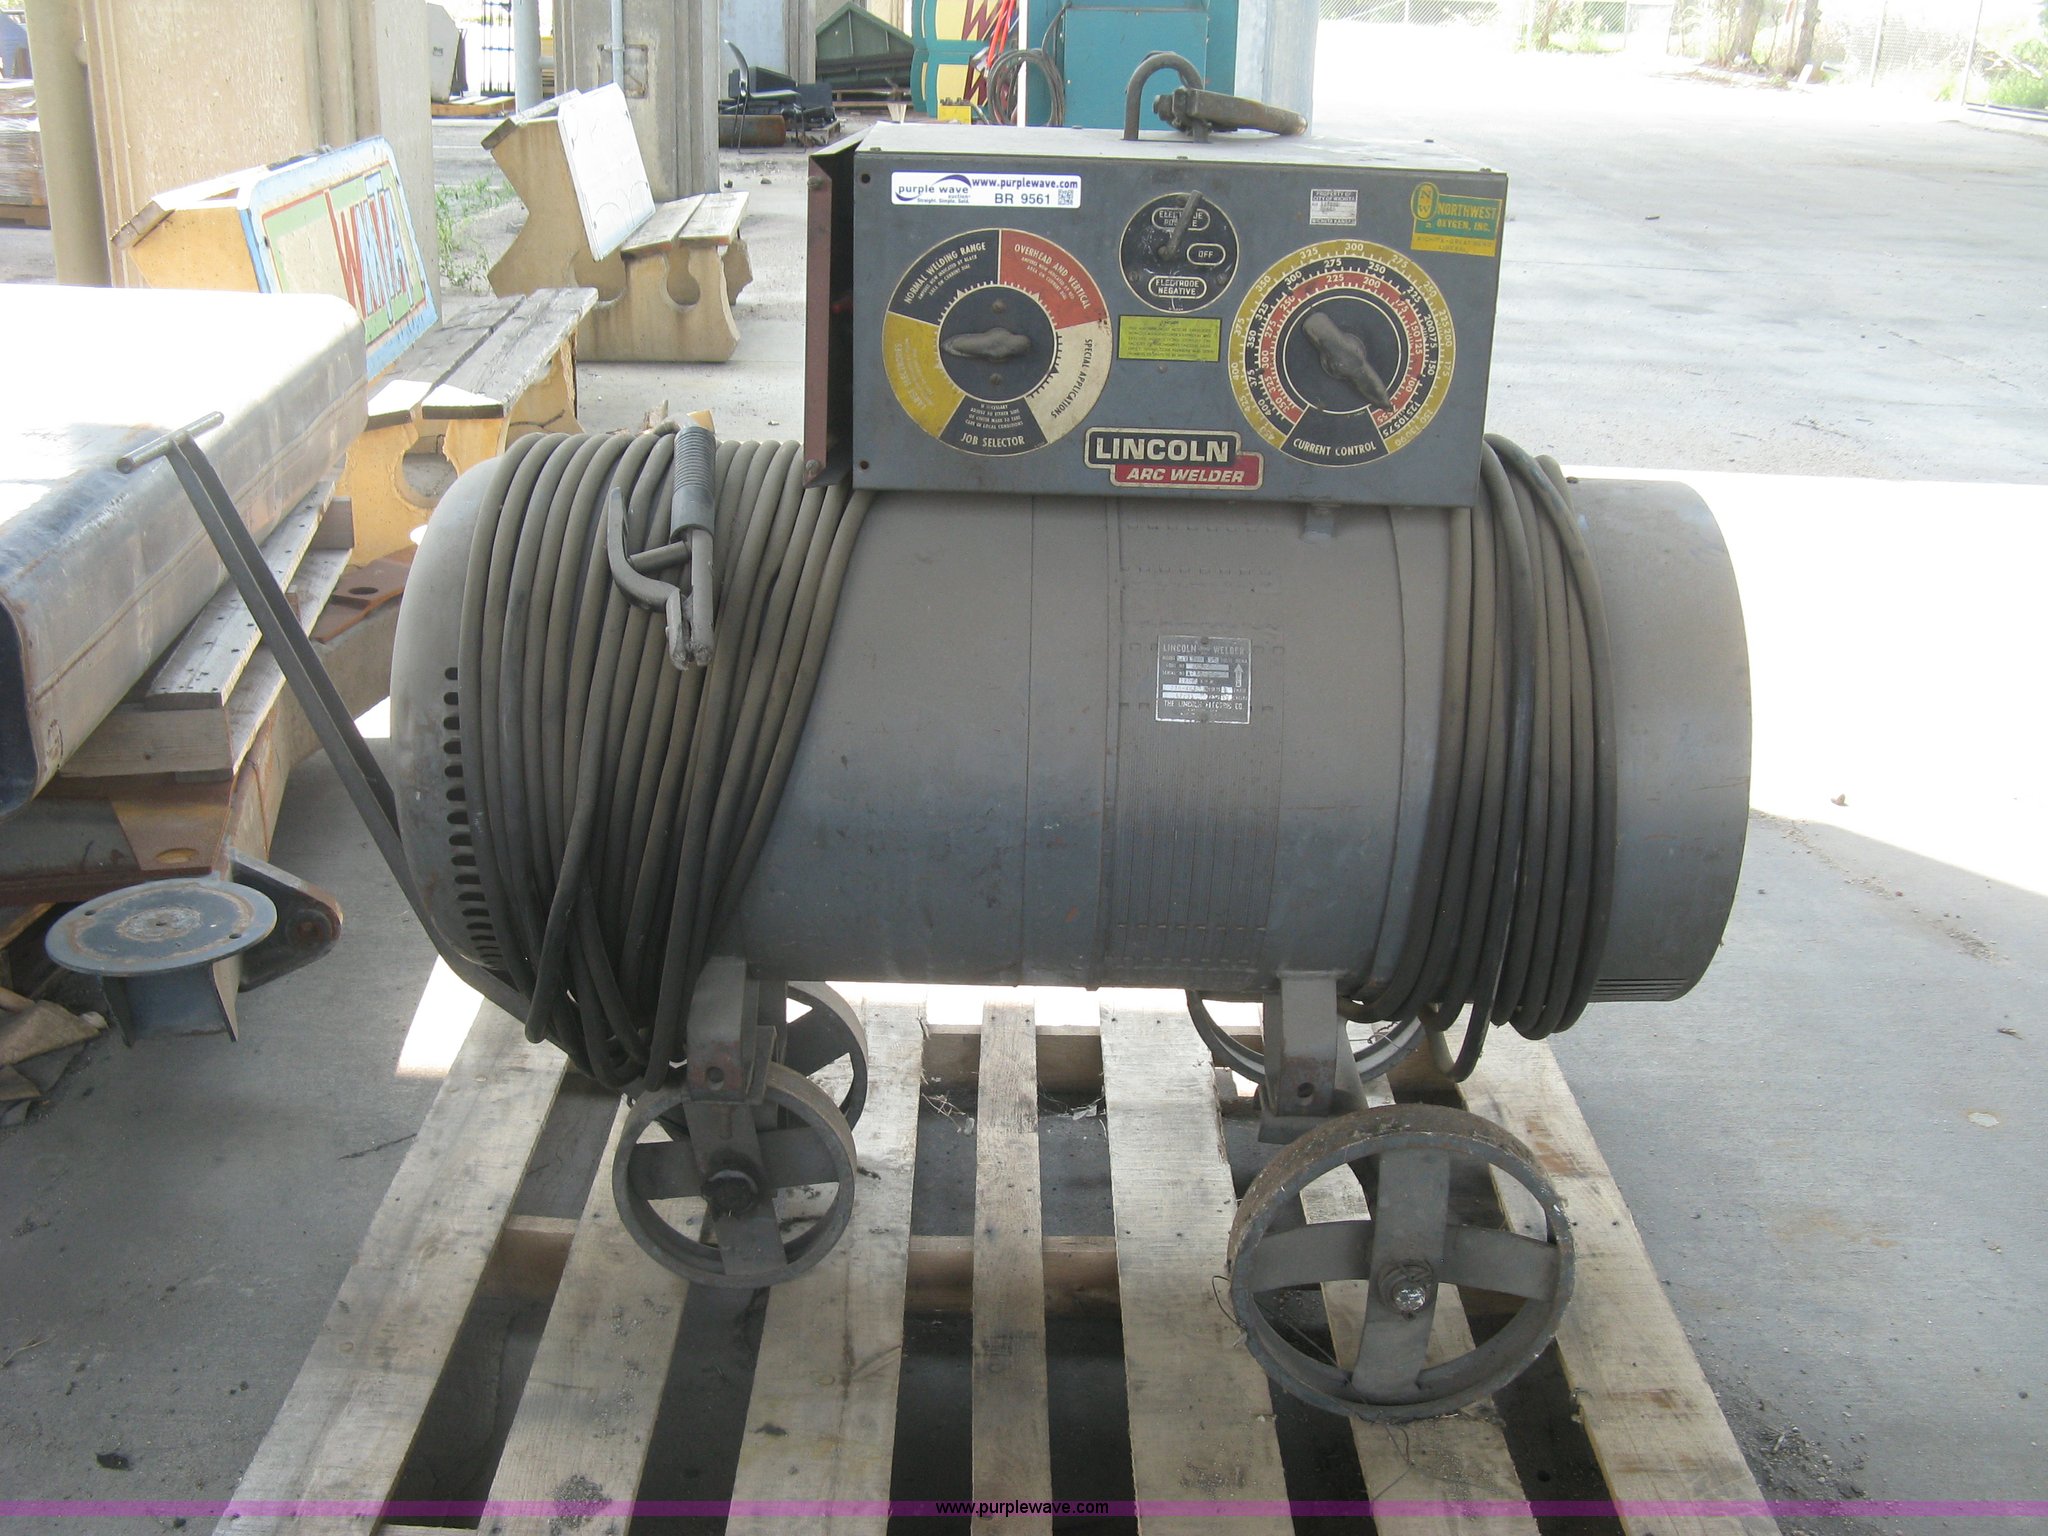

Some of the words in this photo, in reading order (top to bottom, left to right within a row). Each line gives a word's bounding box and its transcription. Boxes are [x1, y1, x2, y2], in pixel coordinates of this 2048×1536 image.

[898, 184, 935, 196] purple
[938, 186, 969, 194] wave
[972, 177, 1078, 190] www.purplewave.com
[994, 193, 1014, 205] BR
[1021, 193, 1050, 205] 9561
[1438, 202, 1497, 220] NORTHWEST
[1198, 250, 1214, 258] OFF
[1300, 246, 1319, 260] 325
[1345, 242, 1364, 252] 300
[1323, 258, 1342, 268] 275
[1368, 261, 1386, 275] 250
[1392, 254, 1409, 268] 275
[904, 274, 928, 304] NORMAL
[926, 251, 958, 275] WELDING
[960, 242, 986, 255] RANGE
[1014, 243, 1052, 264] OVERHEAD
[1053, 263, 1068, 276] AND
[1067, 275, 1092, 309] VERTICAL
[1284, 270, 1302, 286] 300
[1326, 274, 1344, 283] 225
[1156, 279, 1199, 288] ELECTRODE
[1255, 275, 1271, 292] 350
[1362, 276, 1381, 289] 200
[1422, 281, 1437, 297] 250
[1158, 287, 1196, 296] NEGATIVE
[1407, 286, 1422, 303] 225
[1280, 295, 1296, 311] 250
[1395, 299, 1409, 313] 175
[1255, 303, 1270, 321] 325
[1439, 309, 1450, 327] 225
[1233, 317, 1245, 336] 375
[1264, 319, 1277, 338] 275
[1410, 320, 1420, 338] 150
[1423, 314, 1435, 333] 200
[1247, 330, 1257, 349] 350
[1444, 329, 1453, 347] 200
[1081, 339, 1093, 368] SPECIAL
[1414, 338, 1424, 355] 125
[1261, 350, 1270, 369] 300
[1231, 362, 1240, 380] 400
[1427, 360, 1437, 376] 150
[1442, 360, 1452, 377] 175
[1247, 369, 1257, 387] 375
[1264, 376, 1276, 393] 325
[1406, 377, 1418, 392] 100
[1050, 370, 1087, 419] APPLICATIONS
[1258, 399, 1272, 416] 400
[1275, 396, 1290, 413] 350
[1406, 401, 1421, 416] 125
[1420, 409, 1434, 424] 150
[1382, 424, 1396, 437] 75
[961, 432, 979, 446] JOB
[982, 435, 1025, 448] SELECTOR
[1293, 438, 1331, 456] CURRENT
[1335, 441, 1377, 457] CONTROL
[1096, 437, 1229, 463] LINCOLN
[1126, 467, 1166, 481] ARC
[1170, 468, 1245, 483] WELDER
[1163, 643, 1197, 653] LINCOLN
[1213, 646, 1244, 655] WELDER
